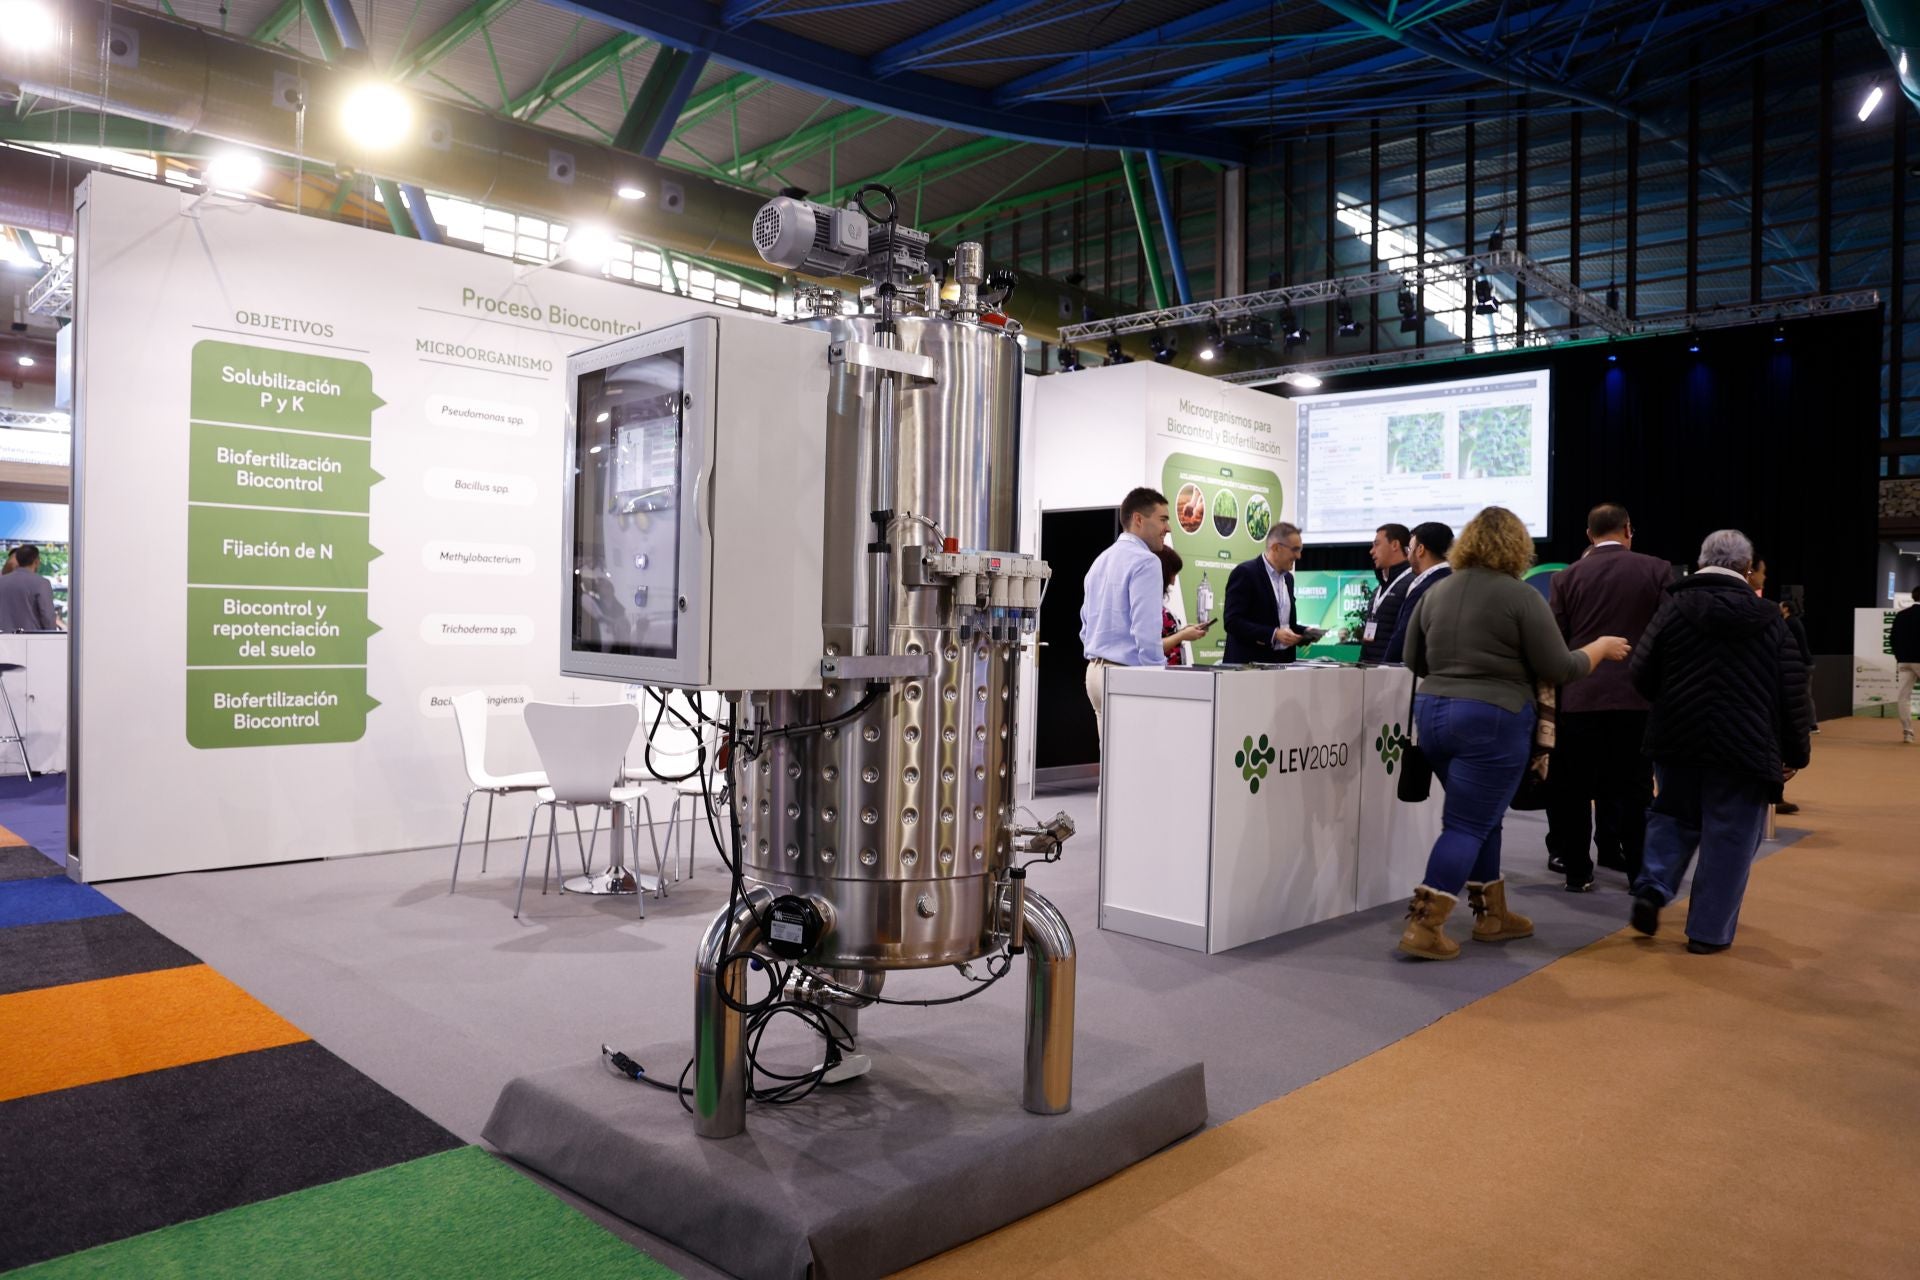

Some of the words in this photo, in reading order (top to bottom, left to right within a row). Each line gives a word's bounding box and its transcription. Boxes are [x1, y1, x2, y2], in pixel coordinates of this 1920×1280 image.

[462, 287, 542, 322] Proceso
[235, 310, 334, 338] OBJETIVOS
[415, 338, 553, 372] MICROORGANISMO
[222, 366, 341, 396] Solubilización
[260, 392, 272, 408] P
[276, 399, 287, 413] y
[292, 396, 304, 412] K
[441, 405, 505, 423] Pseudomonas
[1179, 398, 1252, 428] Microorganismos
[1253, 420, 1271, 433] para
[1167, 417, 1213, 440] Biocontrol
[1215, 432, 1221, 444] y
[1222, 430, 1281, 455] Biofertilización
[217, 447, 342, 473] Biofertilización
[237, 470, 323, 492] Biocontrol
[454, 479, 490, 492] Bacillus
[223, 539, 290, 559] Fijación
[295, 542, 316, 559] de
[320, 544, 333, 559] N
[439, 551, 521, 565] Methylobacterium
[223, 598, 312, 617] Biocontrol
[316, 604, 327, 620] y
[213, 621, 340, 640] repotenciación
[441, 624, 498, 634] Trichoderma
[238, 640, 265, 657] del
[270, 641, 316, 657] suelo
[213, 691, 338, 709] Biofertilización
[234, 711, 320, 729] Biocontrol
[1279, 742, 1348, 774] LEV2050
